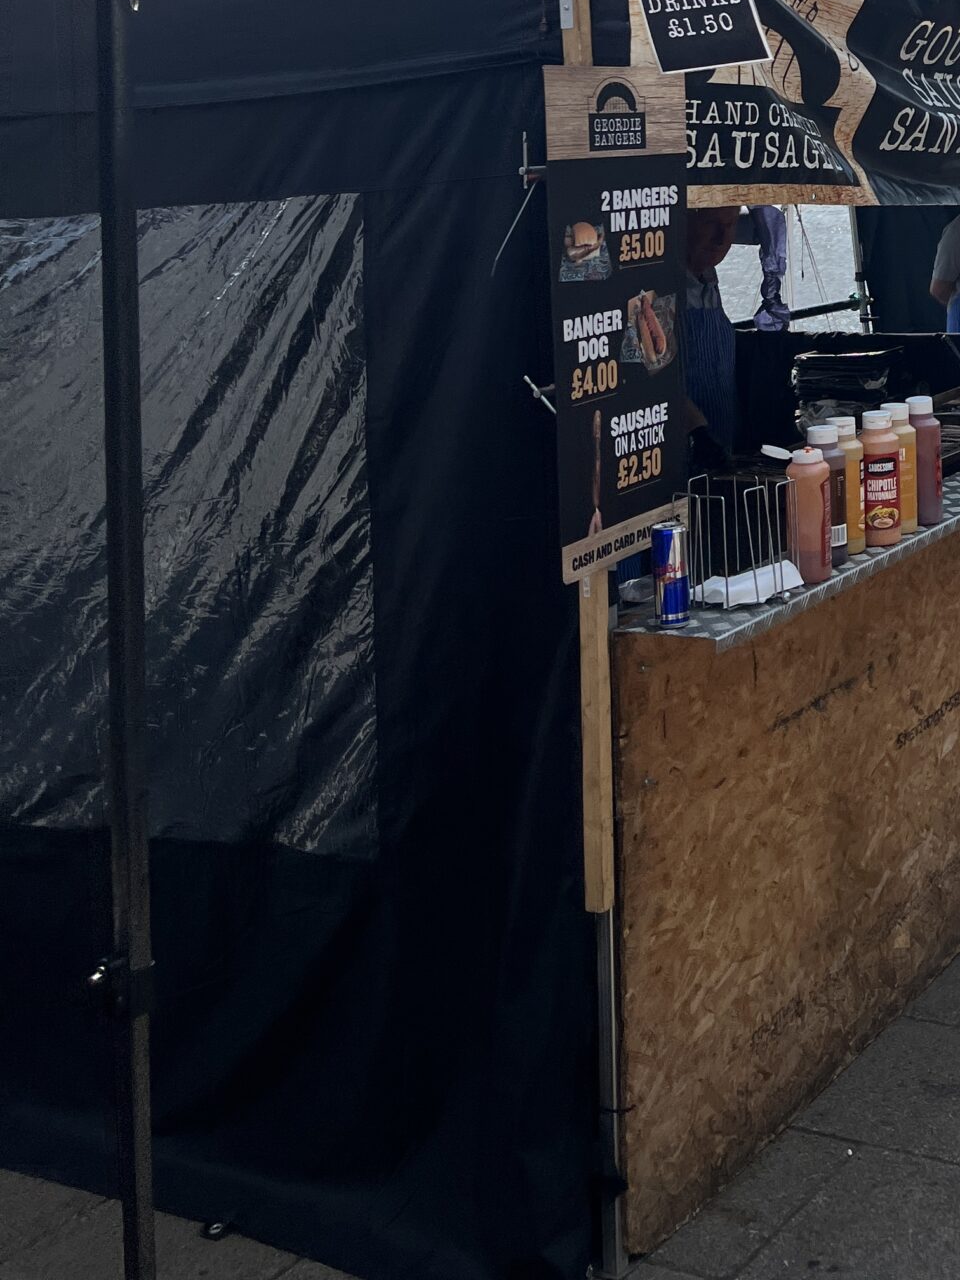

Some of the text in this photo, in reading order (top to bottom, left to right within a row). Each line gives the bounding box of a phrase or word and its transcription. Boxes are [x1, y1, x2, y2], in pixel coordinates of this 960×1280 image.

[668, 12, 734, 38] £1.50
[594, 118, 641, 132] GEORDIE
[685, 100, 759, 125] HAND
[594, 132, 642, 146] BANGERS
[601, 185, 678, 212] 2 BANGERS
[610, 207, 670, 232] IN A BUN
[619, 230, 665, 262] £5.00
[563, 309, 623, 342] BANGER
[578, 335, 609, 363] DOG
[570, 359, 618, 400] £4.00
[610, 402, 669, 437] SAUSAGE
[615, 424, 665, 458] ON A STICK
[616, 447, 662, 490] £2.50
[867, 477, 897, 491] CHIPOTLE
[867, 489, 897, 501] MAYONNAISE
[572, 551, 595, 572] CASH
[595, 542, 613, 563] AND
[613, 534, 635, 555] CARD
